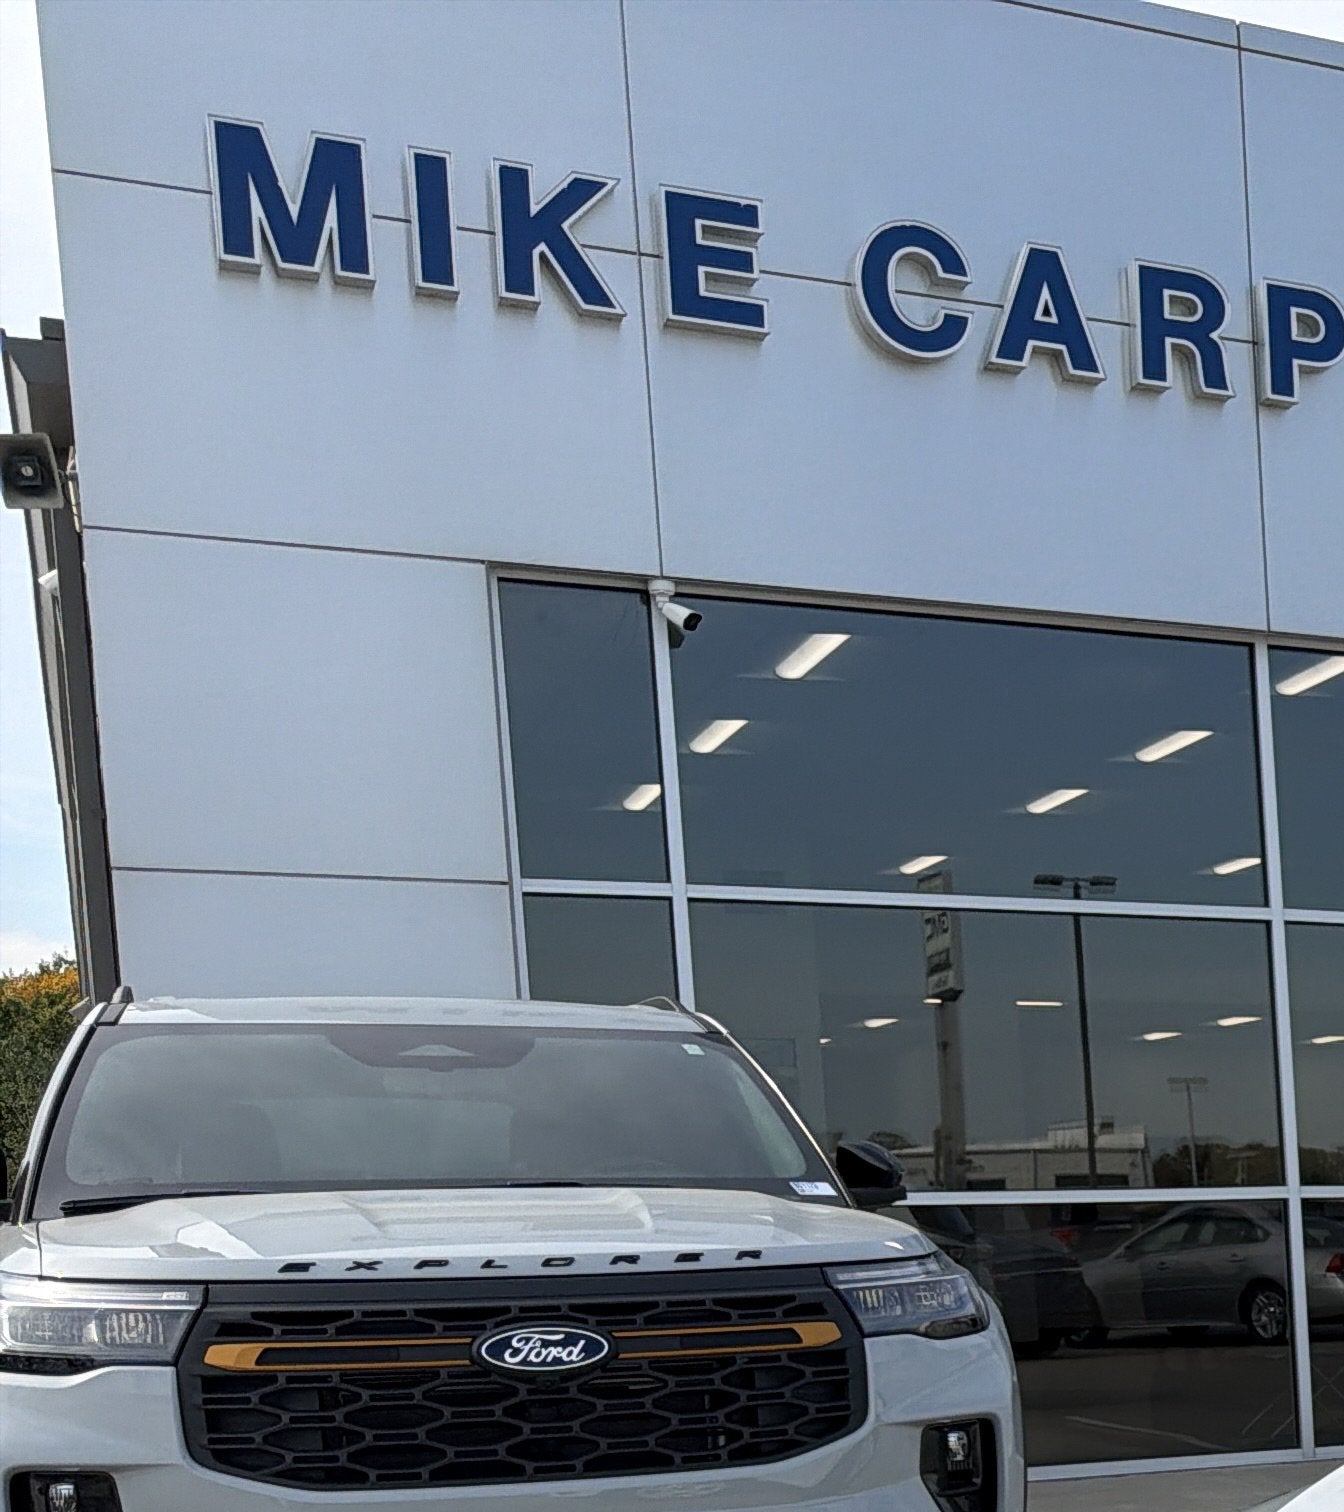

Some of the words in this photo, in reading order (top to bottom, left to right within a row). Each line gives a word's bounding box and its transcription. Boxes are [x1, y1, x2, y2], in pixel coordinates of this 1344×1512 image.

[207, 114, 769, 340] MIKE
[277, 1249, 763, 1273] EXPLORER
[503, 1333, 584, 1363] Ford
